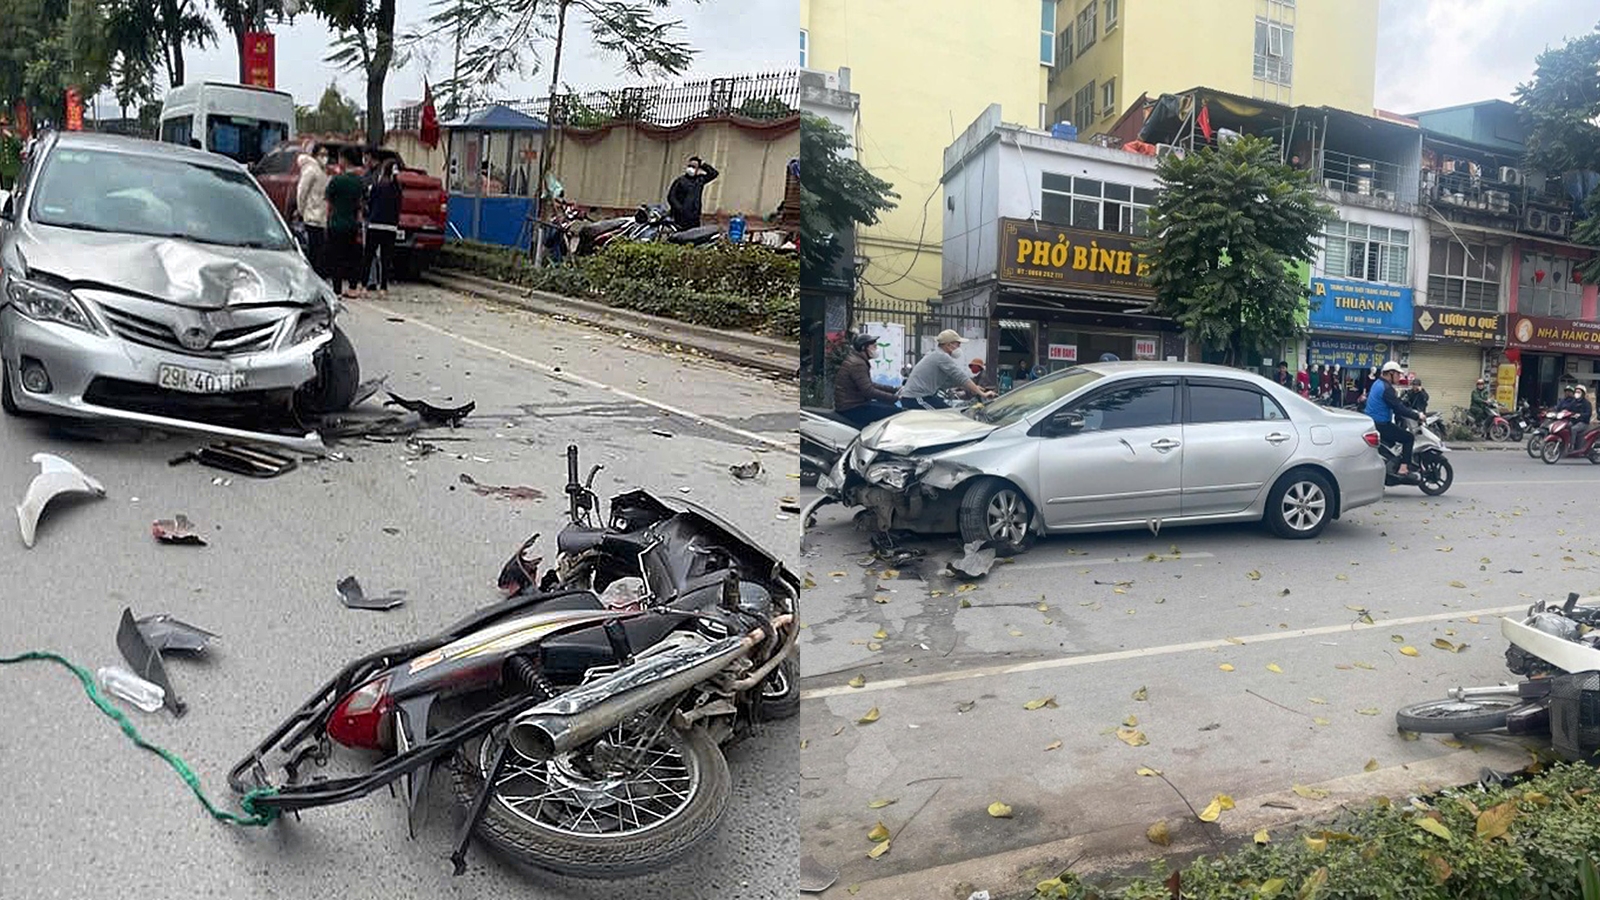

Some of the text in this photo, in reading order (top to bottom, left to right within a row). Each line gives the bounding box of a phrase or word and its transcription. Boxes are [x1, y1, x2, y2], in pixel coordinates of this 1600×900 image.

[1016, 233, 1070, 268] PHỞ
[1072, 240, 1133, 276] BÌNH
[1335, 296, 1394, 312] THUẬN AN
[1438, 313, 1467, 327] LƯƠN
[1468, 316, 1476, 327] O
[1478, 314, 1500, 330] QUẾ
[1537, 326, 1559, 339] NHÀ
[1561, 328, 1590, 341] HÀNG
[1322, 340, 1339, 349] HÀNG
[1340, 341, 1356, 350] XUẤT
